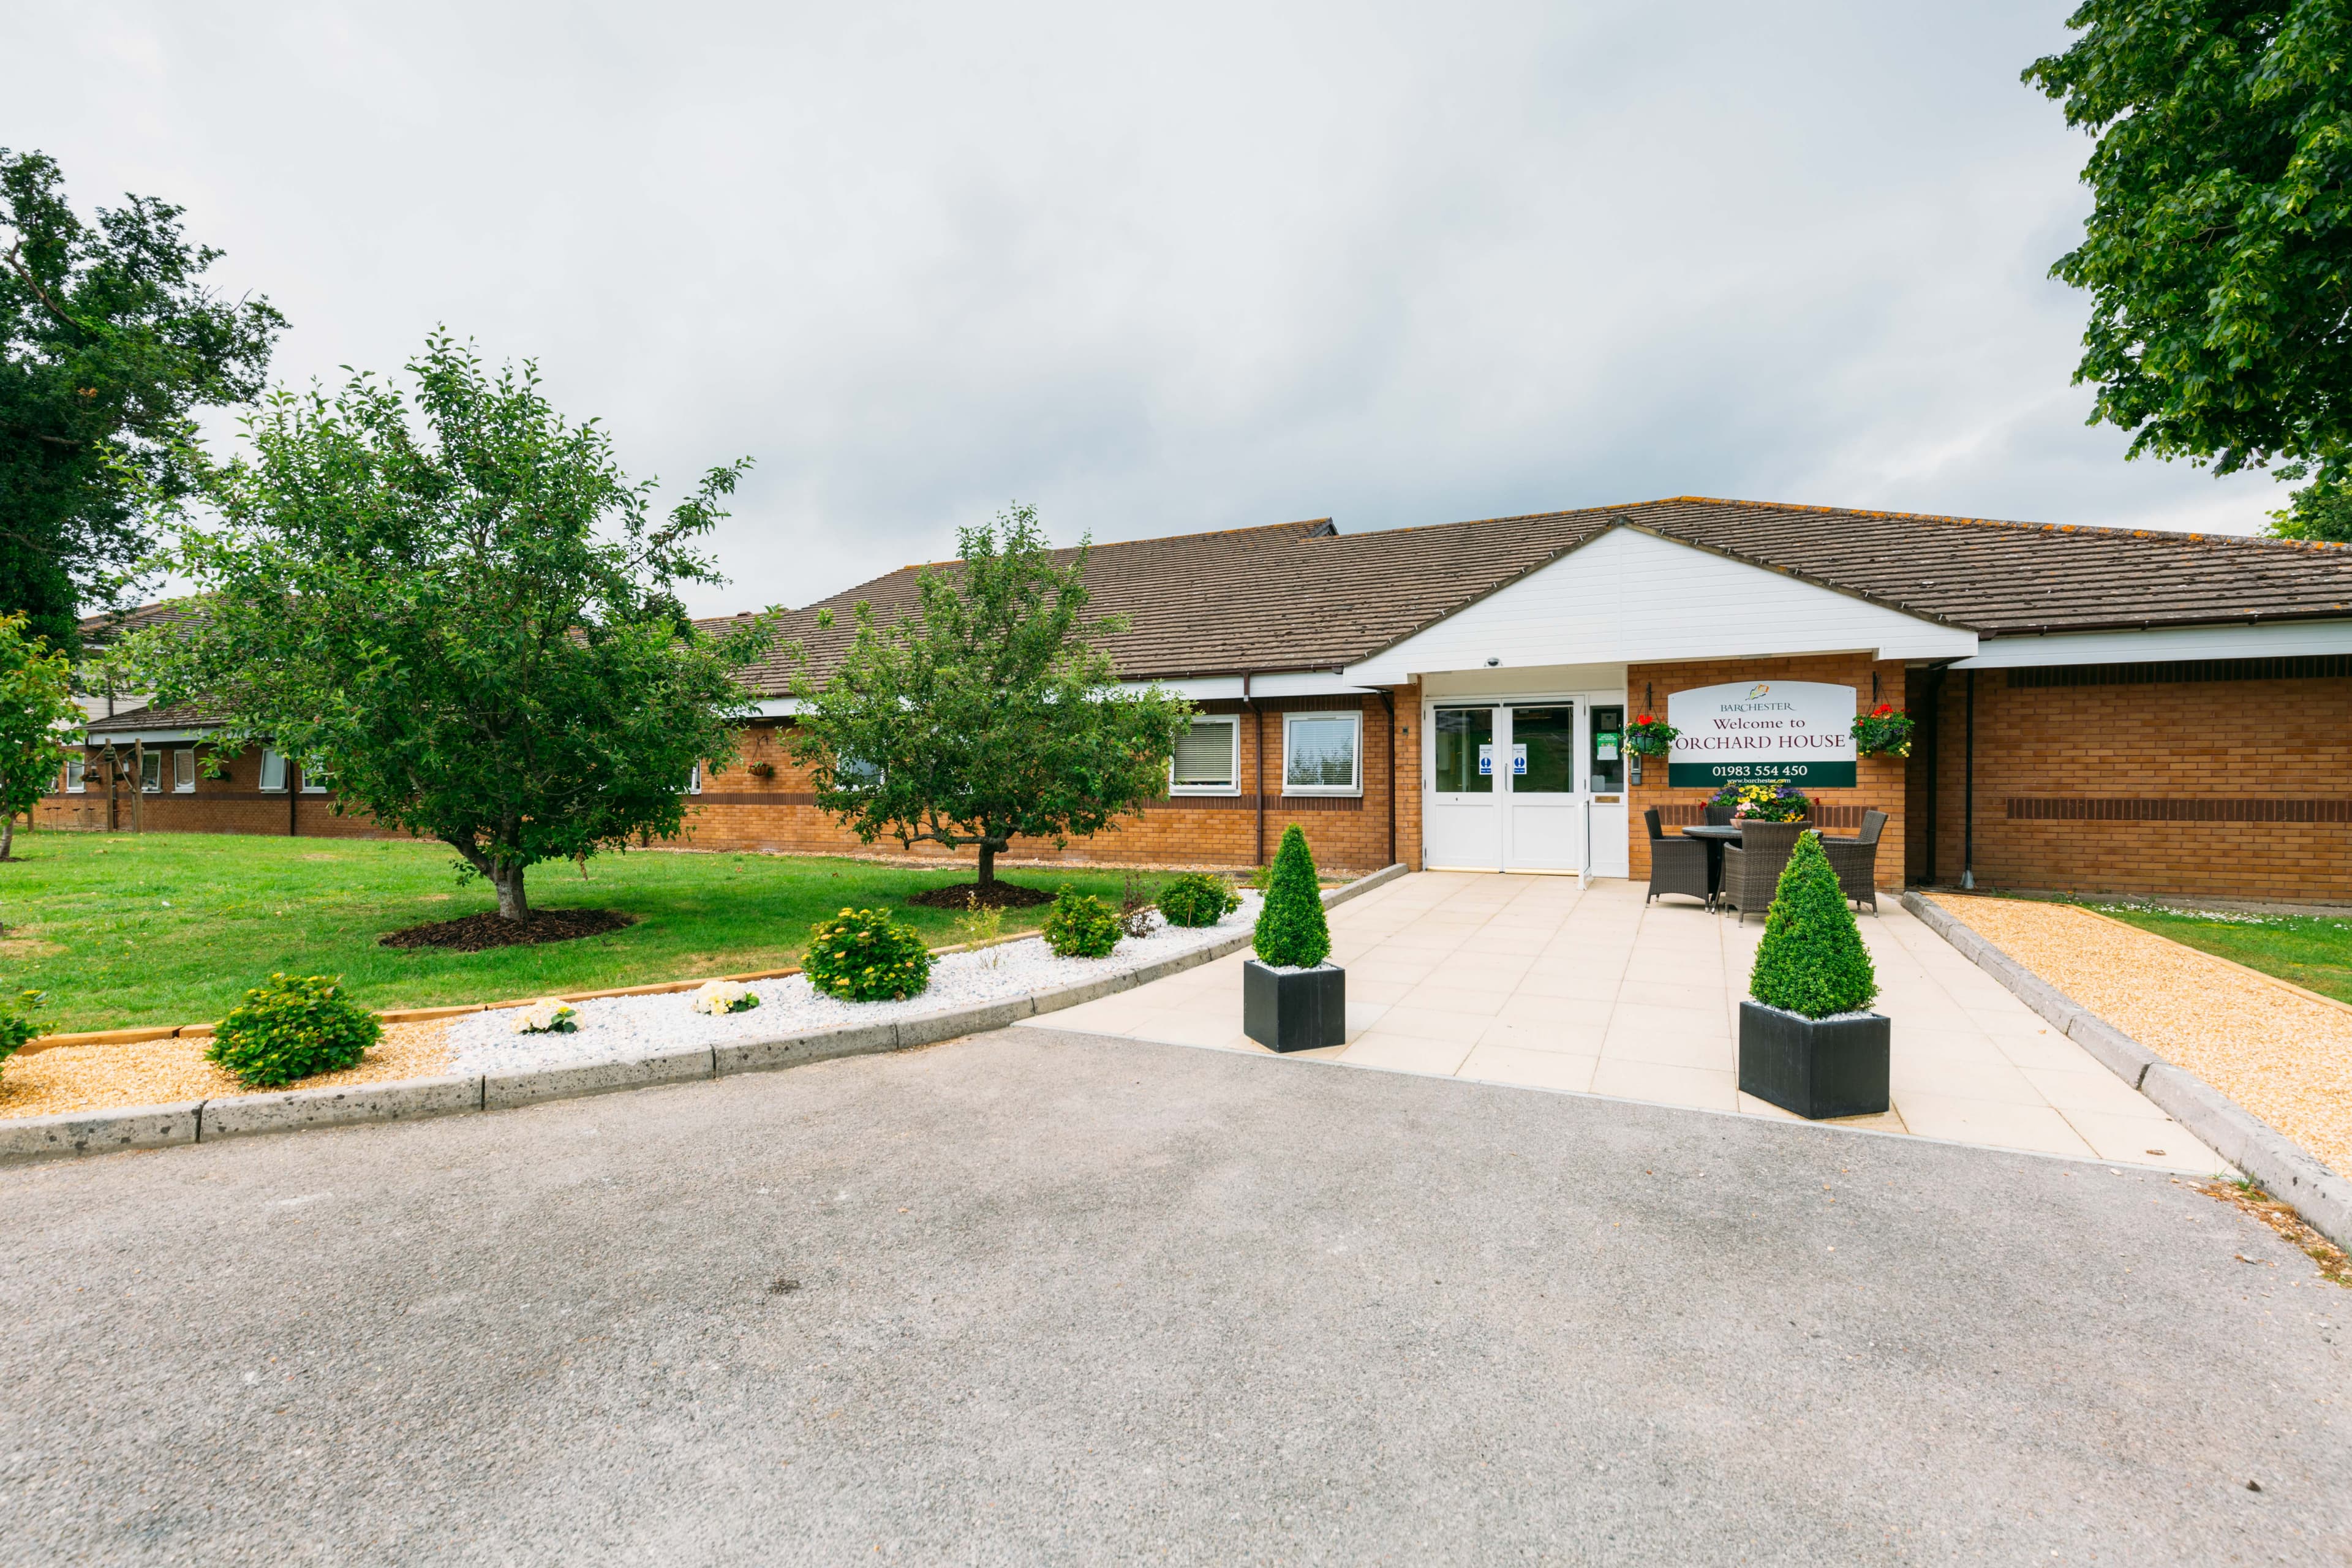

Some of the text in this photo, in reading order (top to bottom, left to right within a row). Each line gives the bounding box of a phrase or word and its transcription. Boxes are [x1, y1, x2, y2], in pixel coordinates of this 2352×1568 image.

[1721, 703, 1797, 712] BARCHESTER
[1713, 718, 1806, 729] Welcome to
[1675, 734, 1845, 750] ORCHARD HOUSE
[1713, 765, 1807, 776] 01983 554 450
